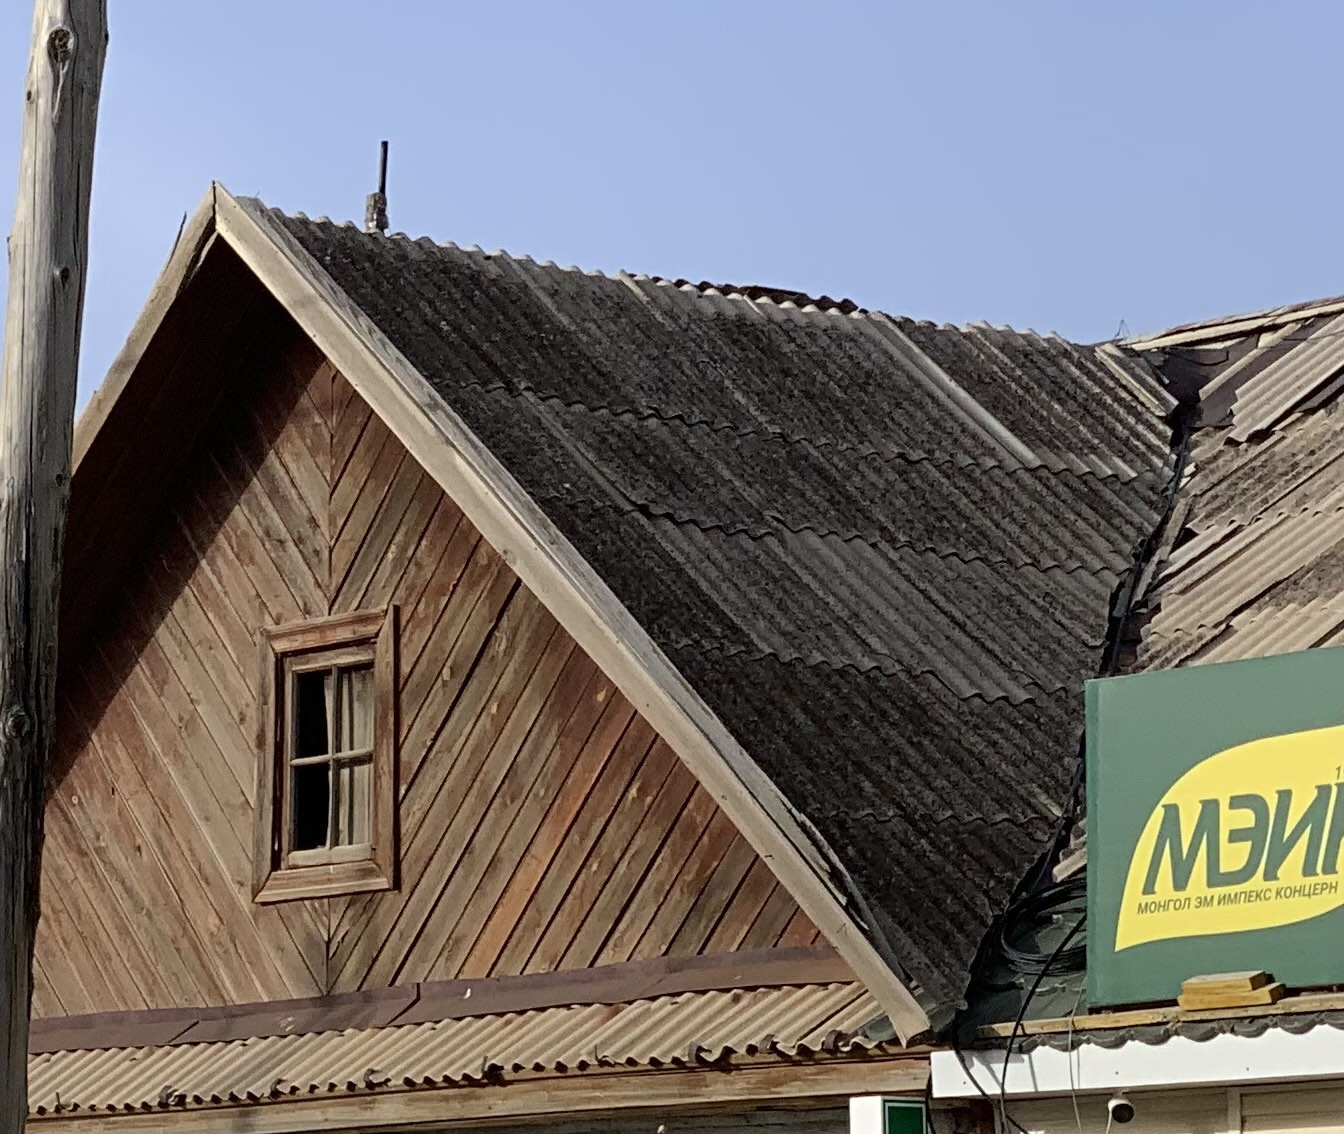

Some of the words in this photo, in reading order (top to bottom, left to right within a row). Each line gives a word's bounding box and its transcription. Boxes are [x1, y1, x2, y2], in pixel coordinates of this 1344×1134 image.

[1137, 896, 1191, 915] МОНГОЛ
[1194, 893, 1214, 909] ЭМ
[1217, 889, 1271, 907] ИМПЕКС
[1275, 881, 1339, 901] КОНЦЕРН
